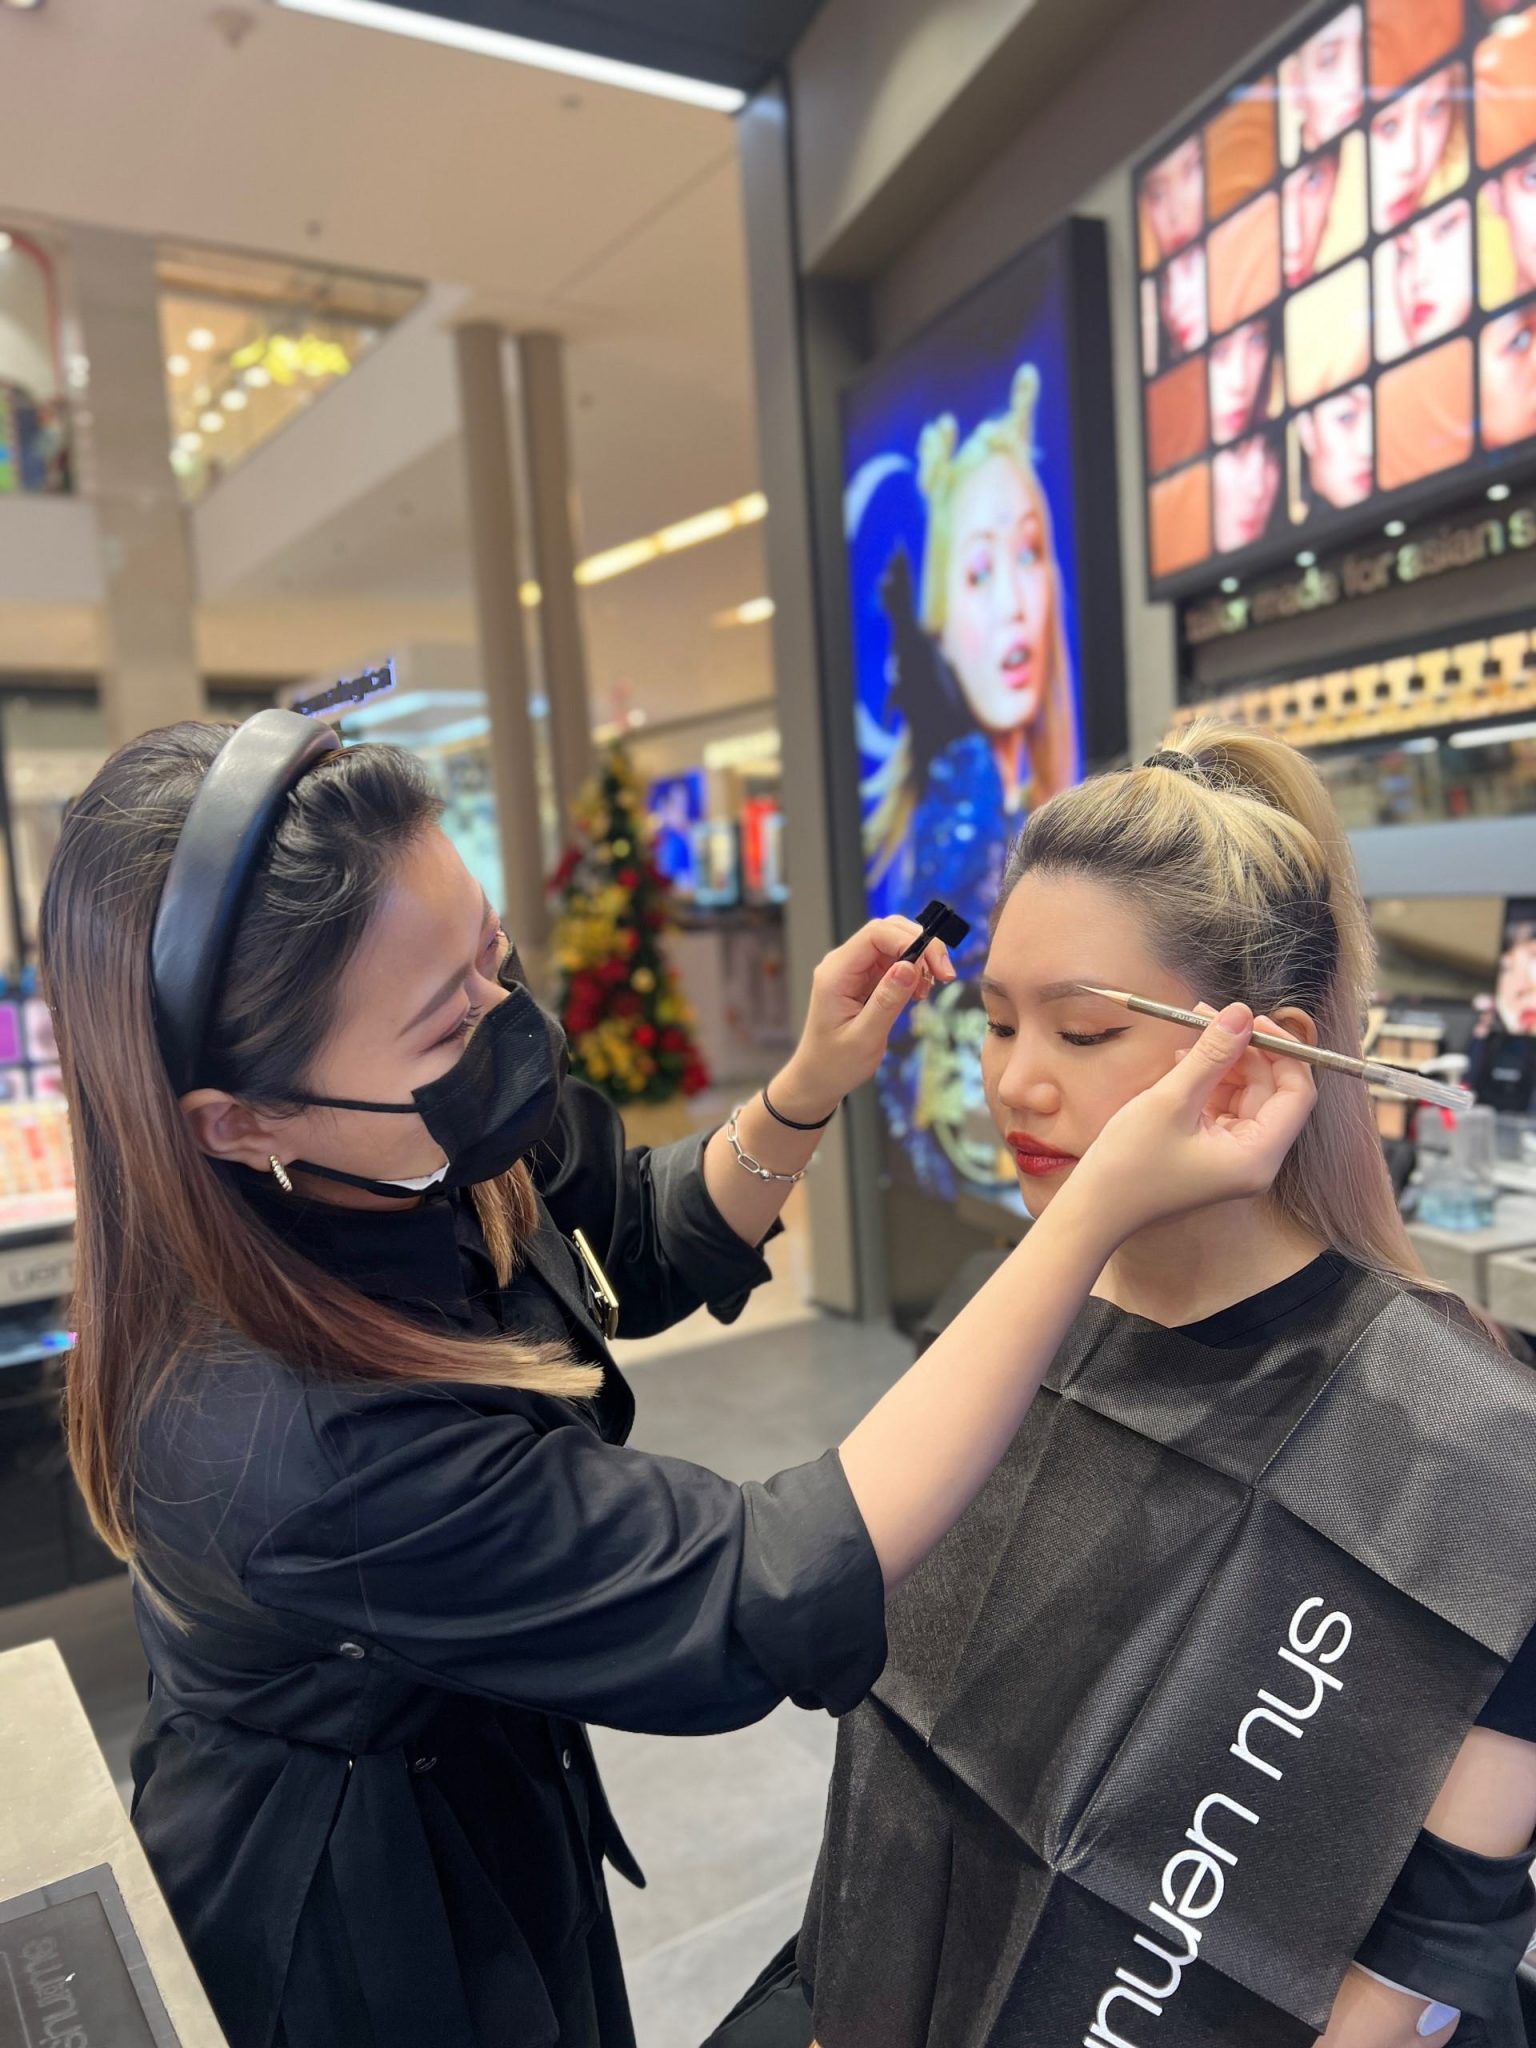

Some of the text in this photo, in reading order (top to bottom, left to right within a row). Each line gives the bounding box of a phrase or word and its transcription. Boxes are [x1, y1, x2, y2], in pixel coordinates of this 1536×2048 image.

[1344, 550, 1392, 597] for
[1397, 518, 1504, 581] asian
[1082, 1596, 1352, 2048] shu uemu
